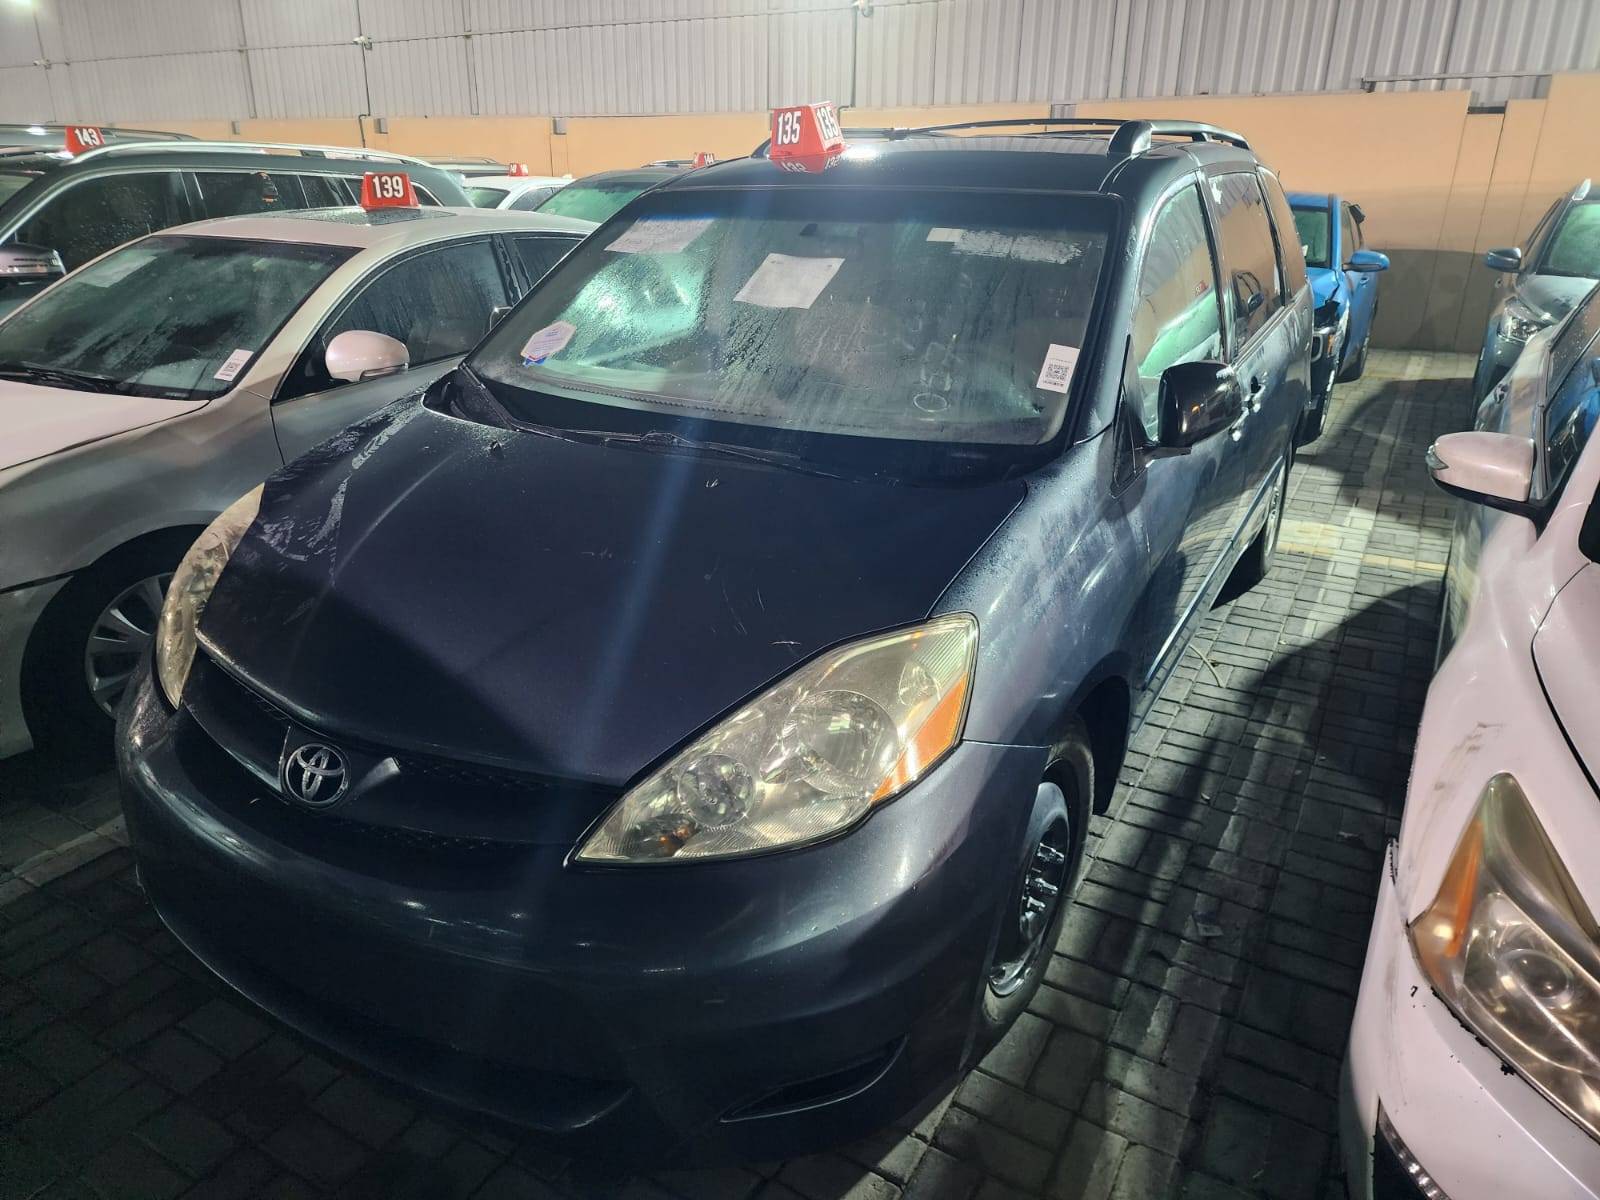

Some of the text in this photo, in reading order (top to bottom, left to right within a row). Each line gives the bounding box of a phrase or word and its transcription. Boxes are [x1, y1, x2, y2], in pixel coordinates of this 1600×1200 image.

[74, 128, 101, 146] 143
[778, 111, 801, 145] 135
[815, 106, 839, 140] 135
[372, 175, 404, 198] 139
